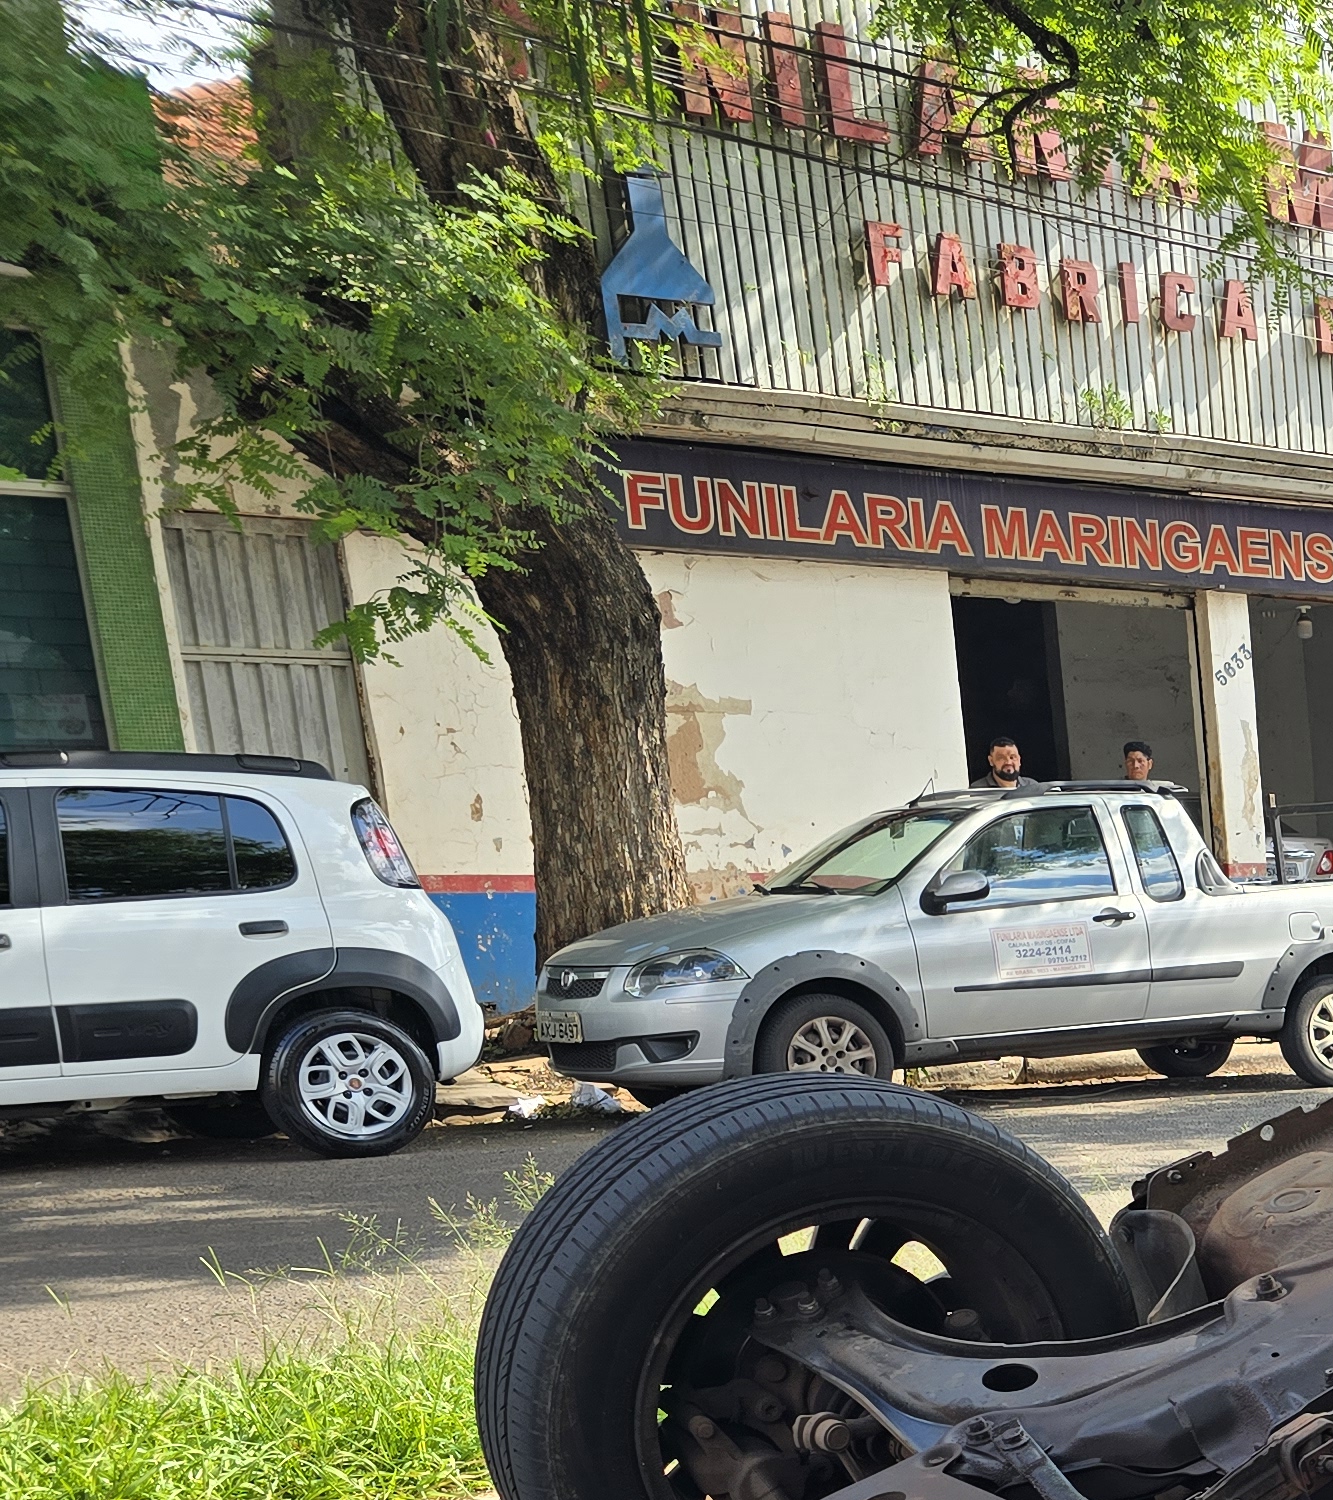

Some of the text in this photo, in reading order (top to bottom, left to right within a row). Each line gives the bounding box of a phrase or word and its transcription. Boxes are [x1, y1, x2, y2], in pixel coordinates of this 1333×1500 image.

[865, 219, 1258, 342] FABRICA
[622, 470, 974, 559] FUNILARIA
[1214, 645, 1254, 688] 5633
[1015, 945, 1072, 959] 3224-2114
